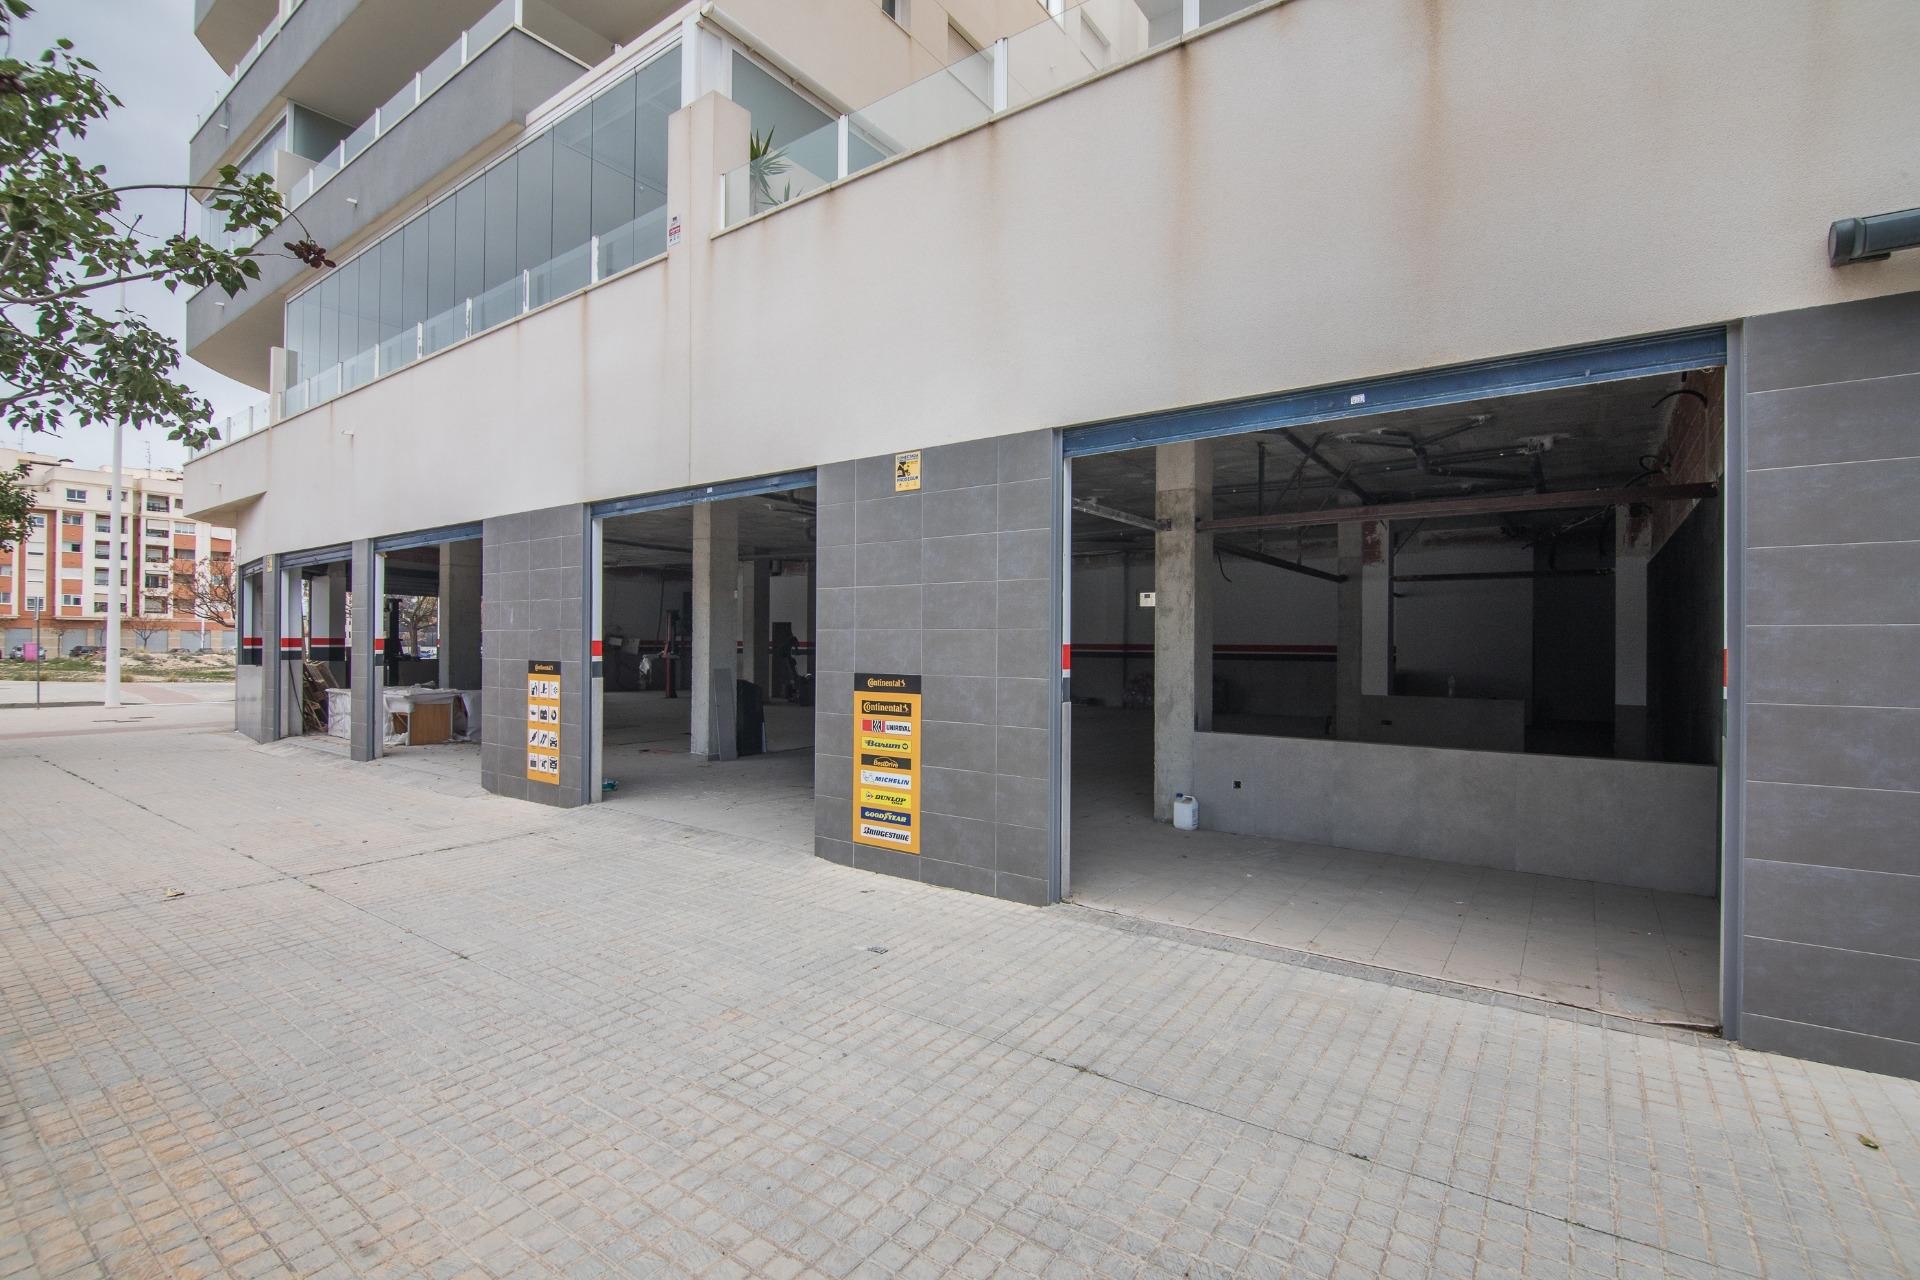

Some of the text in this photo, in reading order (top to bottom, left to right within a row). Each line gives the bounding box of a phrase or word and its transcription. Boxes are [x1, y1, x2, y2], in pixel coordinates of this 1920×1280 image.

[867, 677, 901, 688] Continental
[863, 701, 903, 713] Continental
[886, 724, 911, 732] UNIROYAL
[874, 776, 910, 786] MICHELIN
[874, 794, 907, 803] DUNLOP
[864, 811, 907, 822] GOODYEAR
[863, 827, 909, 841] BRIDGESTONE
